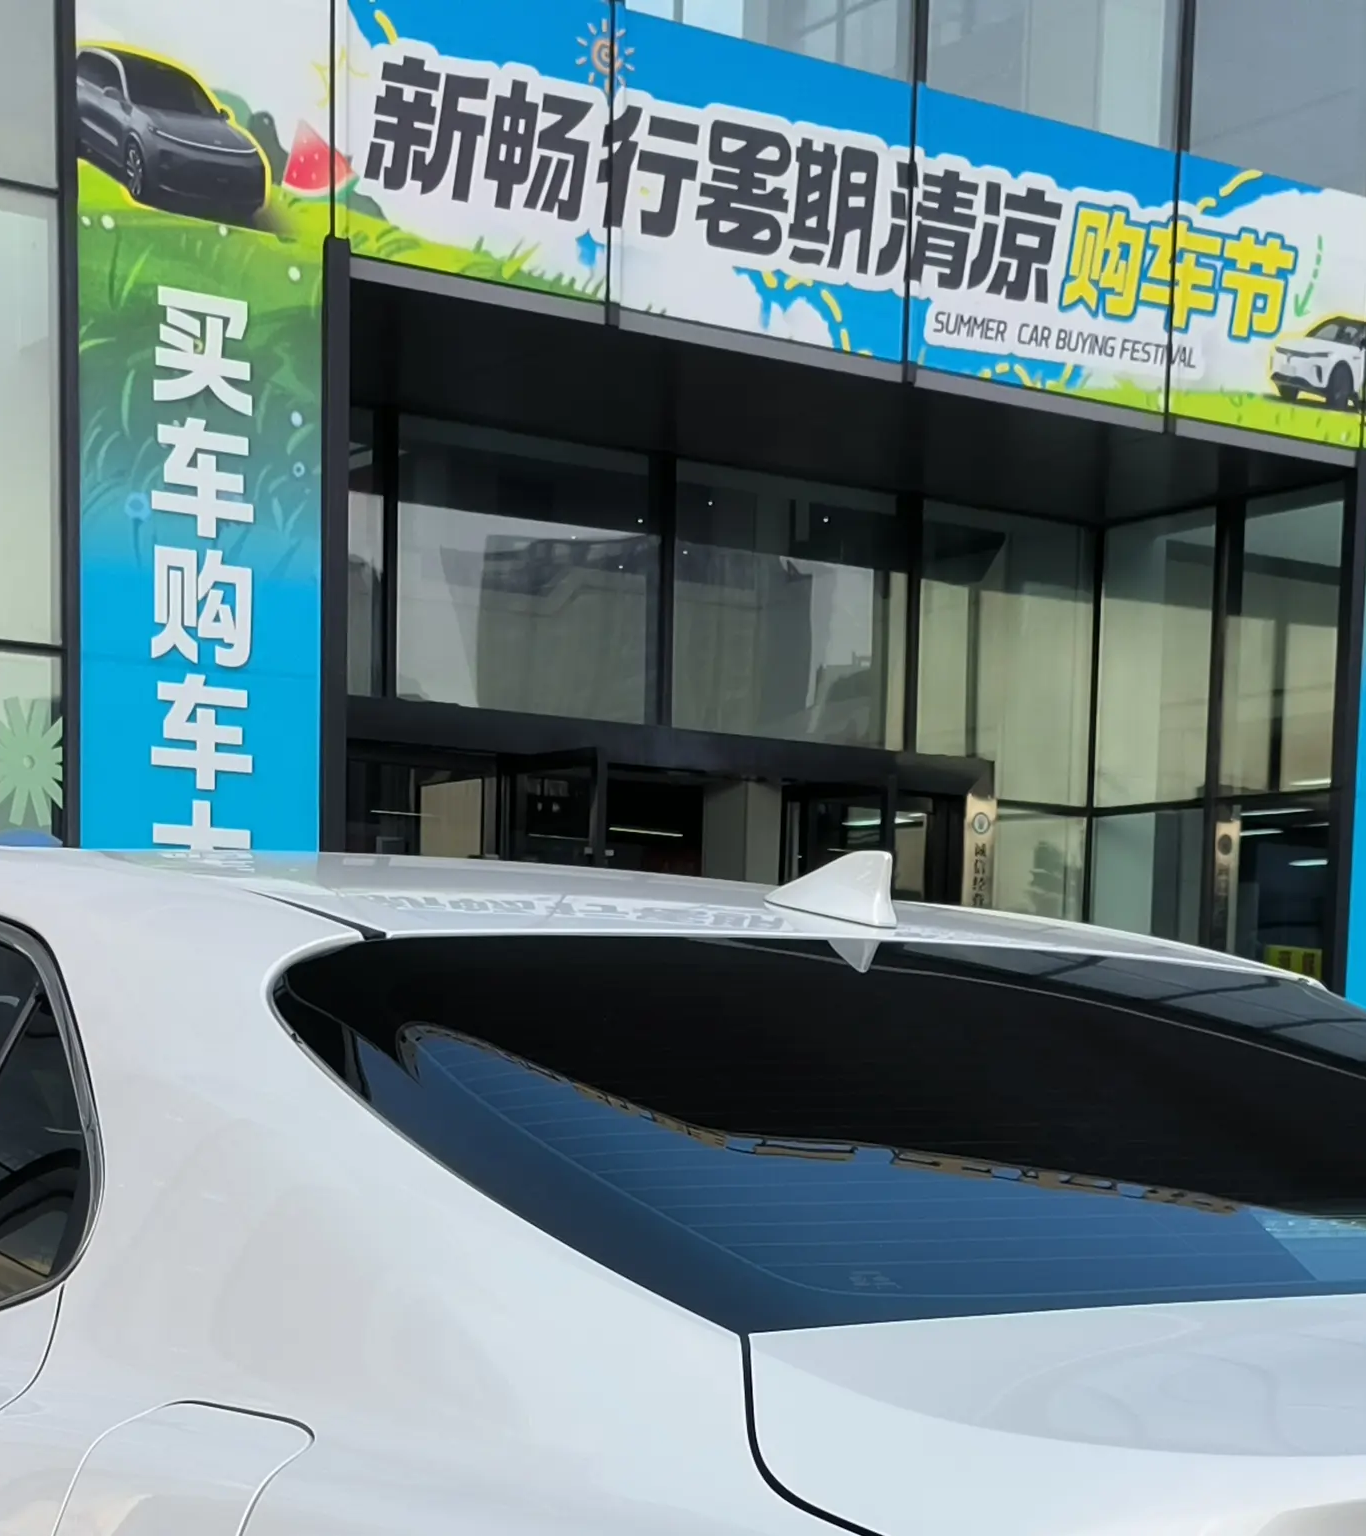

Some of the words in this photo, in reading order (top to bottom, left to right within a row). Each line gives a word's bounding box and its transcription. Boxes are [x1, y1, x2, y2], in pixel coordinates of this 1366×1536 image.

[933, 311, 1008, 342] SUMMER
[1017, 323, 1052, 348] CAR
[1055, 329, 1115, 358] BUYING
[1119, 341, 1197, 369] FESTIVAL
